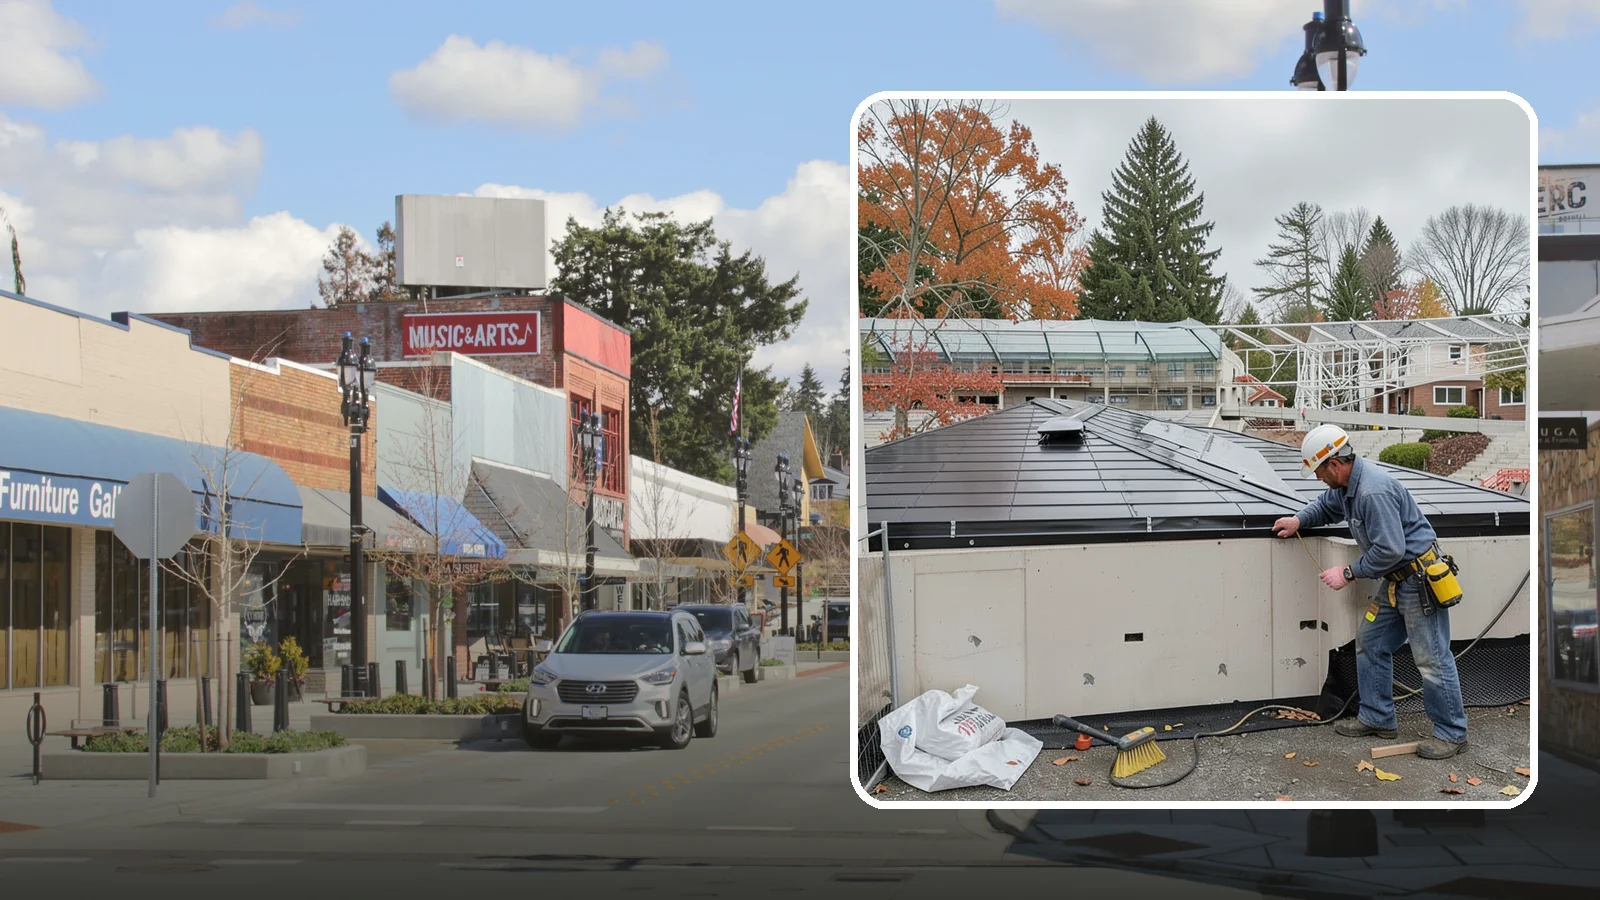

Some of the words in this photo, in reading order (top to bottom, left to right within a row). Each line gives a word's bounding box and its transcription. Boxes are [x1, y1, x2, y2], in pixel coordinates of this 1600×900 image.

[408, 322, 520, 349] MUSIC&ARTS
[0, 471, 80, 515] Furniture
[89, 482, 122, 519] Gal
[453, 563, 479, 574] SUSHI
